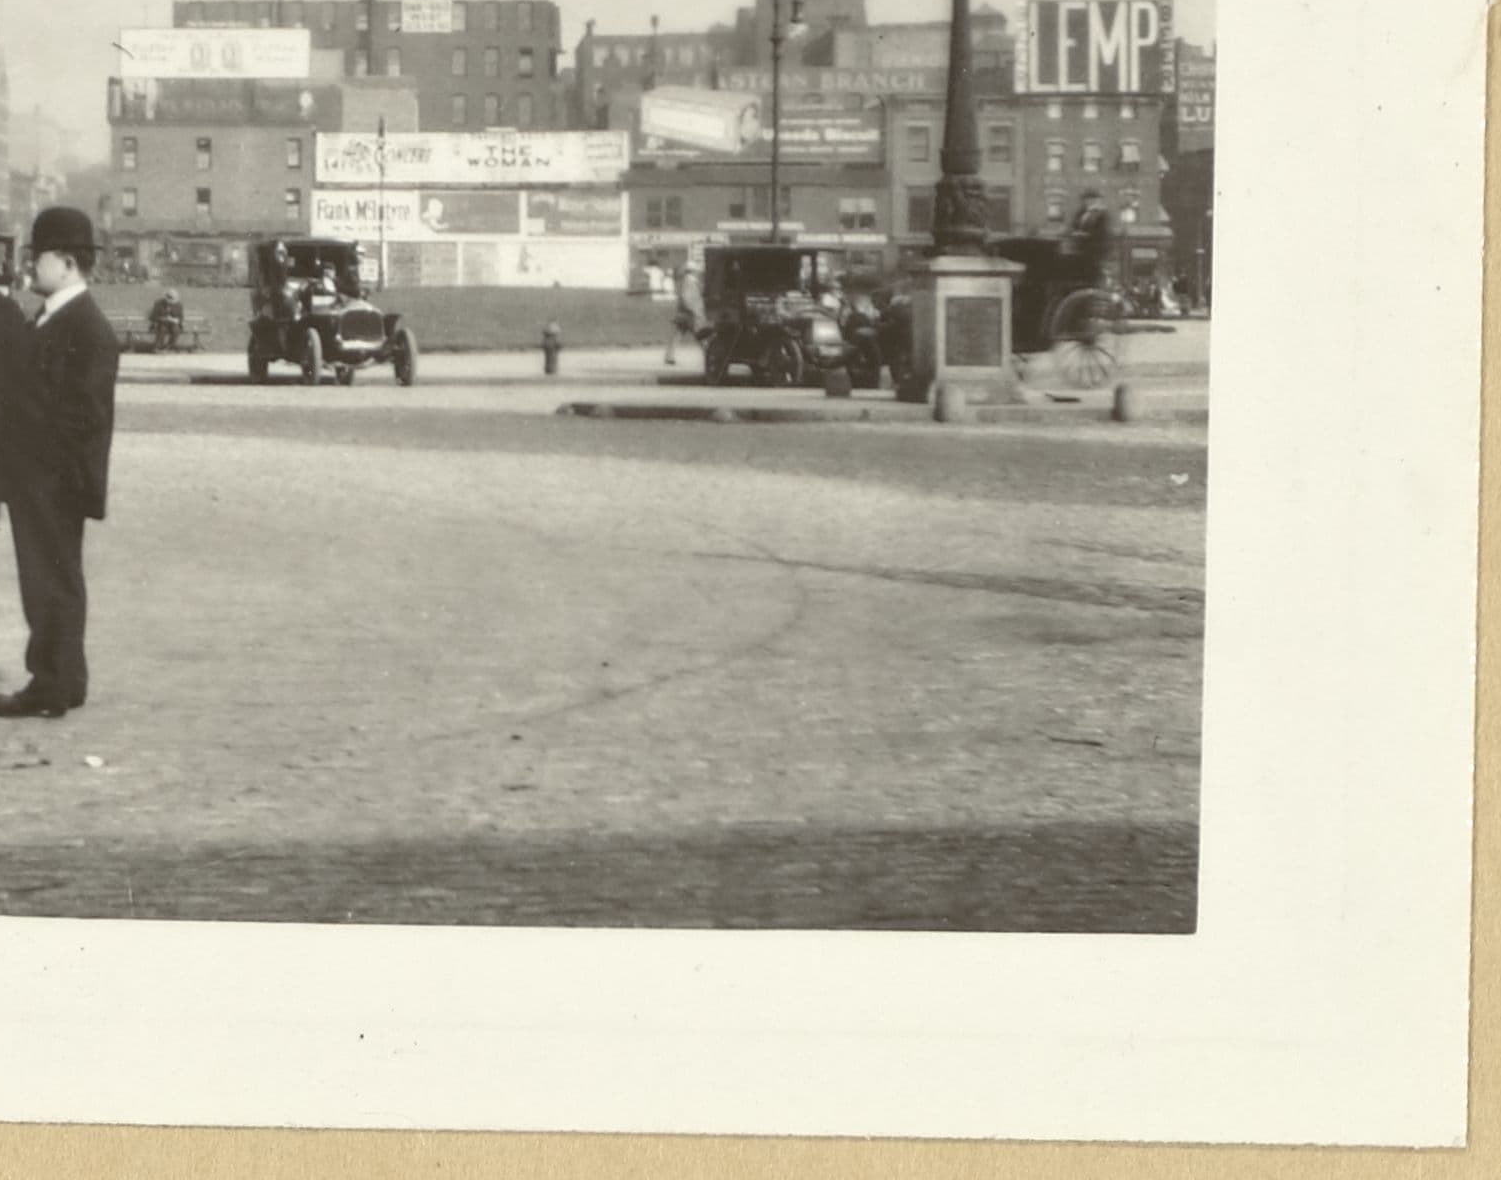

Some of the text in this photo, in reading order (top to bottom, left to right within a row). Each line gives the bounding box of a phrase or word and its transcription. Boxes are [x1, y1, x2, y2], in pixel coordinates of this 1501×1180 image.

[1029, 0, 1159, 93] LEMP
[820, 72, 925, 89] BRANCH
[485, 144, 532, 157] THE
[467, 157, 551, 168] WOMAN
